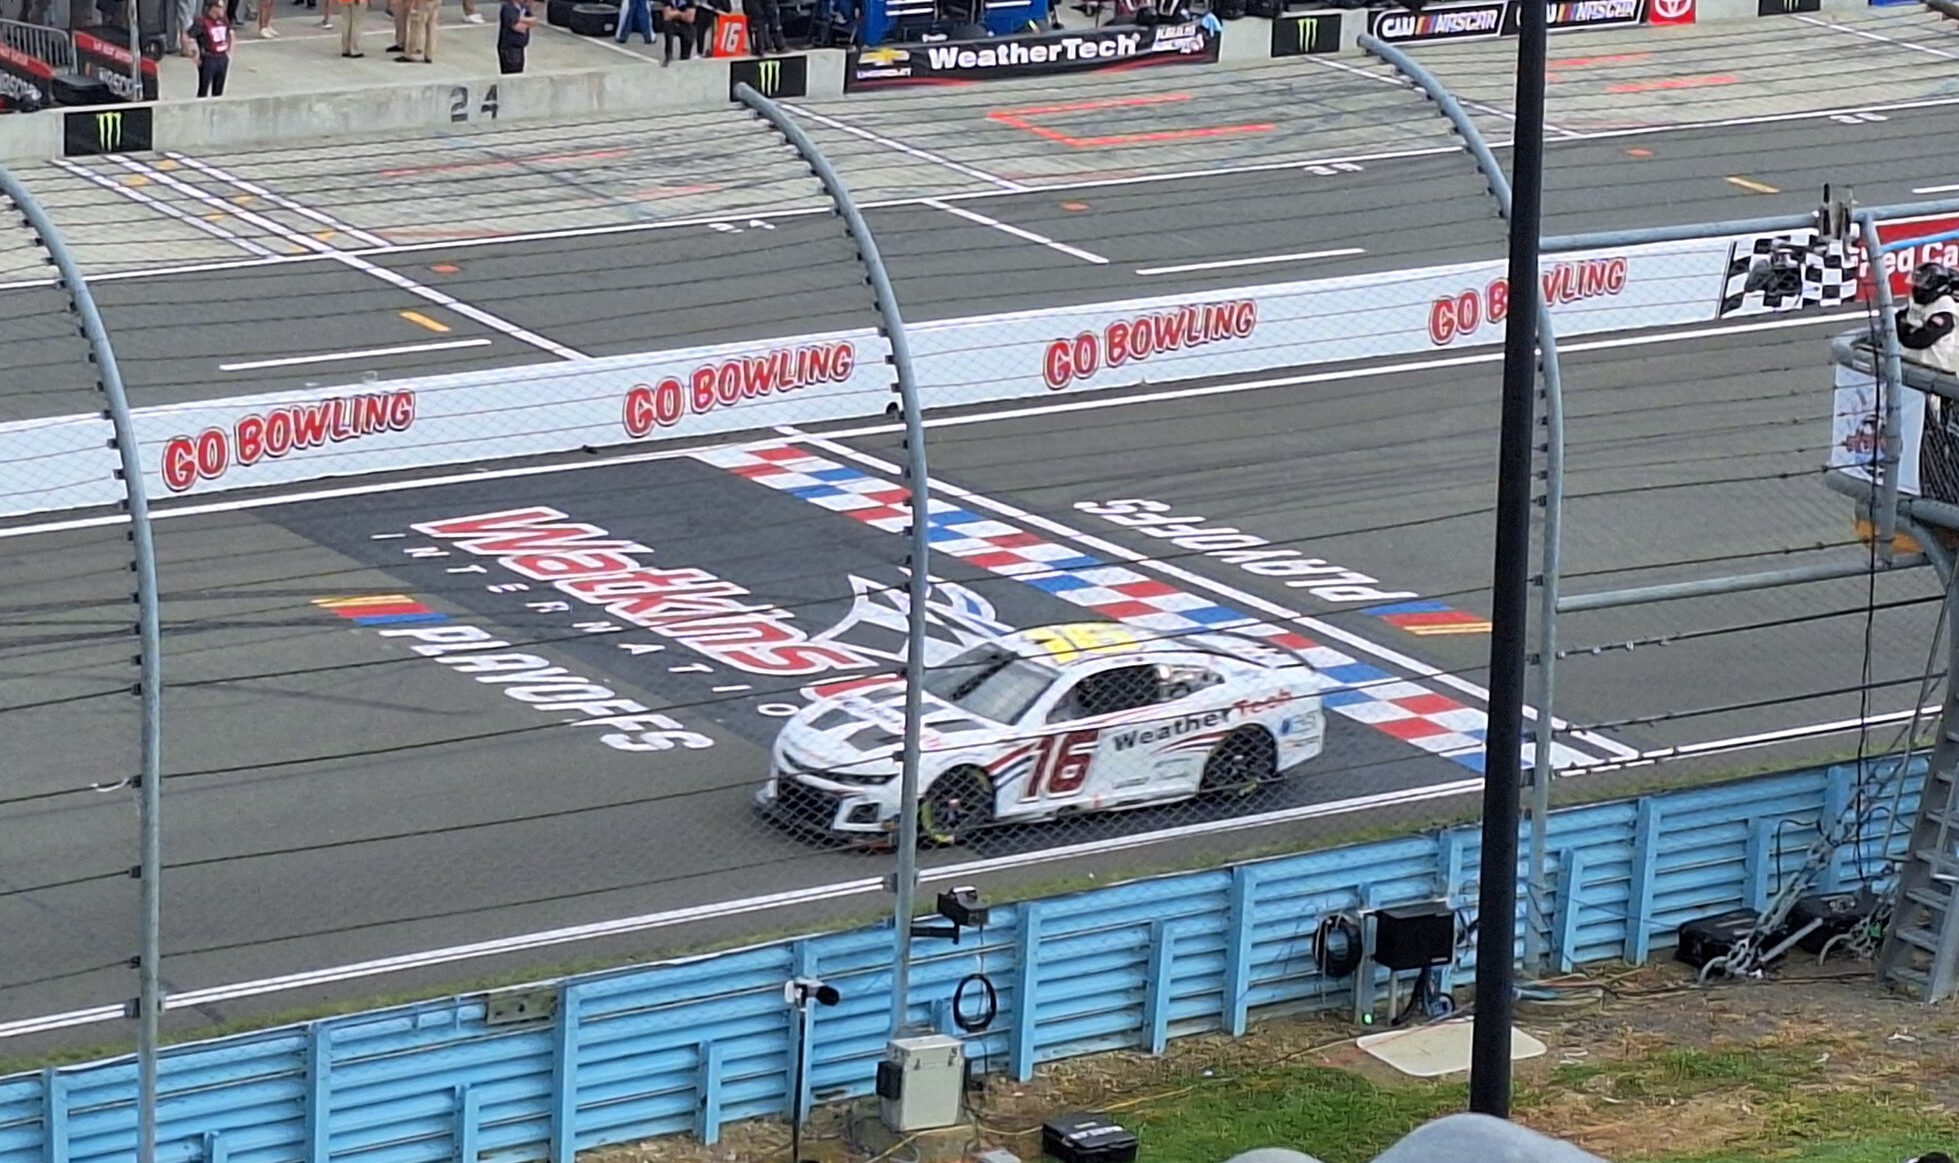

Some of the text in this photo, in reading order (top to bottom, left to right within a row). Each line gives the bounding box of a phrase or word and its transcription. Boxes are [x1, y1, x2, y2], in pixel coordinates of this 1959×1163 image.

[720, 21, 743, 53] 16
[928, 33, 1138, 70] WeatherTech
[1434, 9, 1498, 33] NASCAR
[450, 83, 498, 123] 24
[1044, 299, 1257, 389] GO BOWLING
[1429, 257, 1628, 345] GO BWLING
[624, 341, 854, 438] GO BOWLING
[163, 389, 415, 492] GO BOWLING
[410, 505, 880, 676] Watkins
[1073, 498, 1419, 602] PLAYOFFS
[378, 625, 714, 752] PLAYOFFS
[1020, 728, 1099, 802] 16
